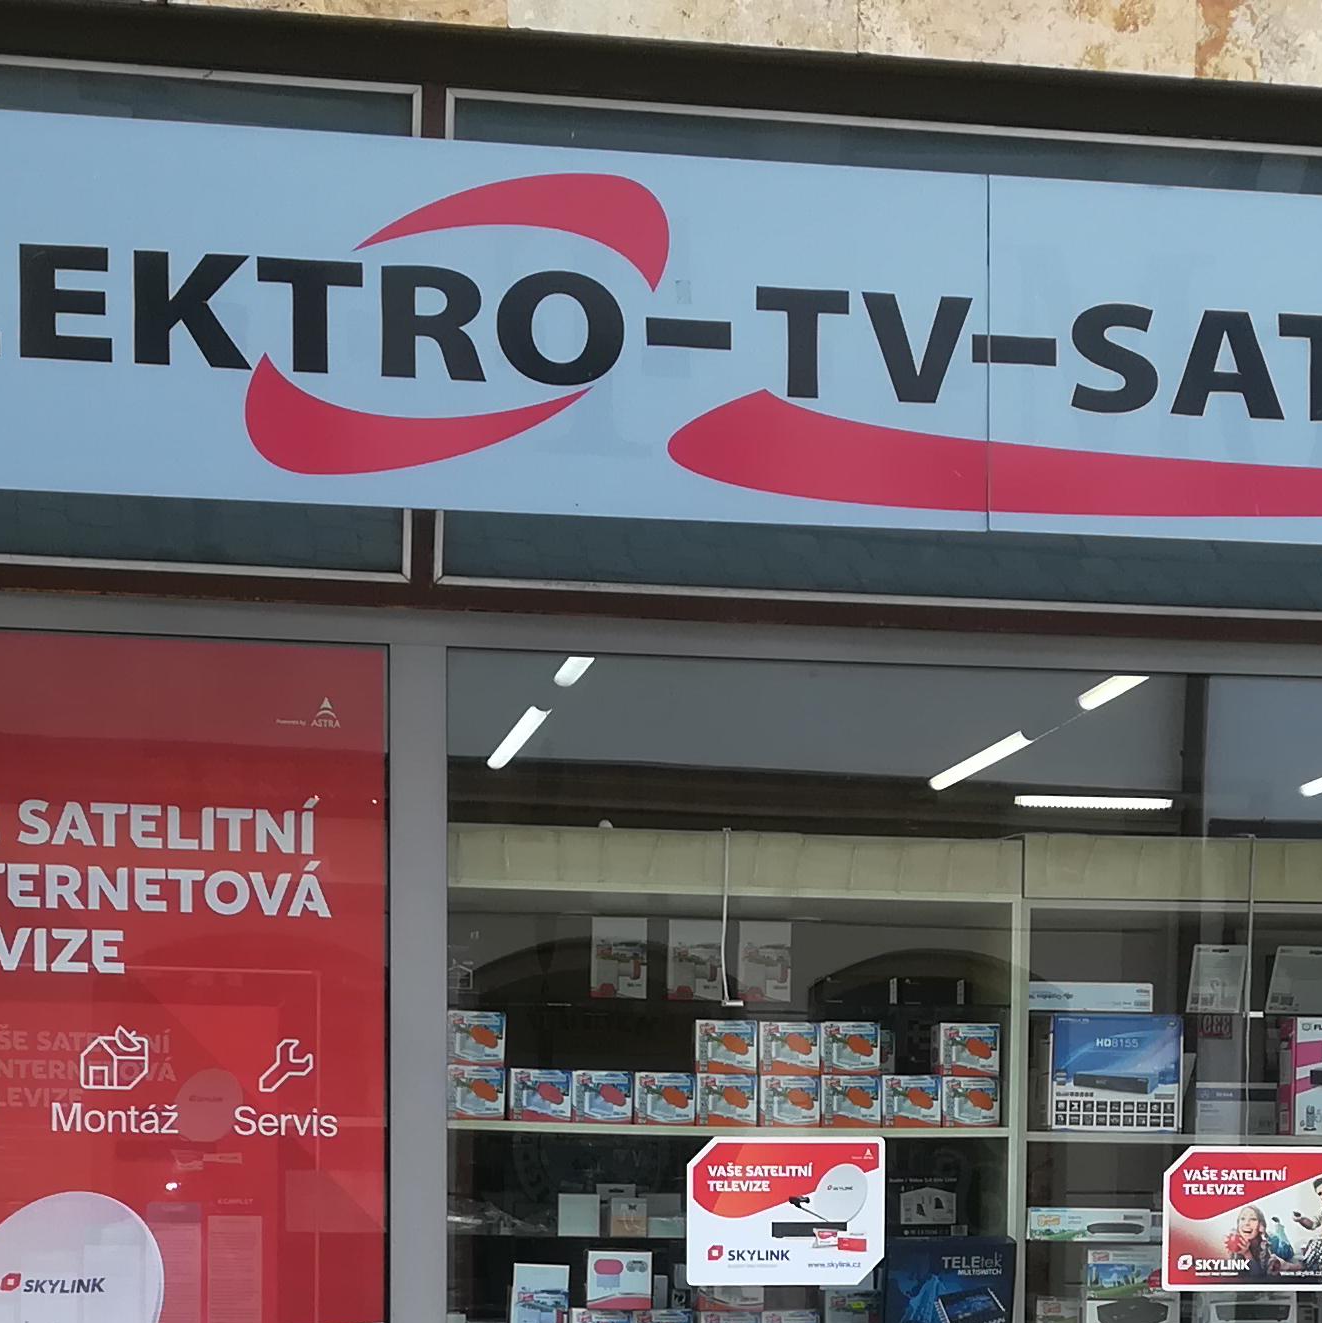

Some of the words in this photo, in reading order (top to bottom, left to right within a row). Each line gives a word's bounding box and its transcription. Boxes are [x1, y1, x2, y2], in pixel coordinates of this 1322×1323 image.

[310, 718, 342, 729] ASTRA
[17, 796, 318, 855] SATELITNÍ
[51, 1102, 180, 1135] Montáž
[233, 1107, 339, 1138] Servis
[707, 1162, 743, 1177] VAŠE
[745, 1162, 814, 1177] SATELITNÍ
[1183, 1165, 1218, 1181] VAŠE
[1220, 1166, 1288, 1181] SATELITNÍ
[707, 1180, 771, 1193] TELEVIZE
[1183, 1183, 1245, 1196] TELEVIZE
[728, 1249, 791, 1262] SKYLINK
[1194, 1258, 1251, 1271] SKYLINK
[22, 1276, 107, 1294] SKYLINK
